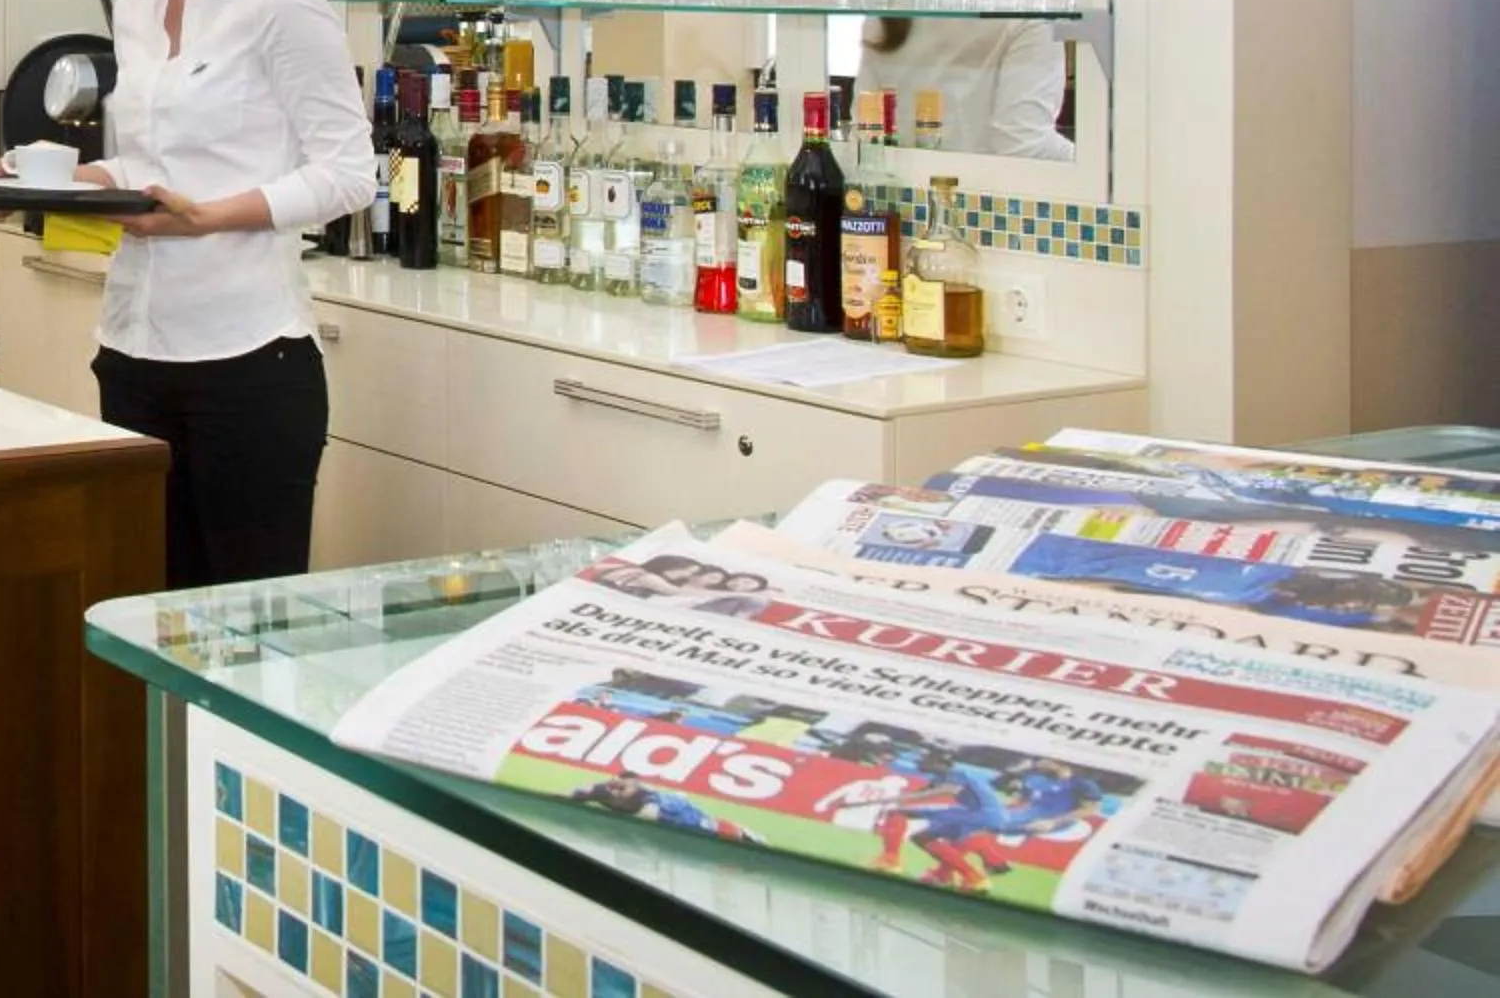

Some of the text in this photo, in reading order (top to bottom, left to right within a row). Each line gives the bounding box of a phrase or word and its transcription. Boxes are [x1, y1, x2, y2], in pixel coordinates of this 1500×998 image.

[542, 618, 593, 638] als
[602, 629, 673, 653] drei
[676, 645, 750, 670] Mal
[754, 663, 799, 680] so
[807, 672, 901, 702] viele
[908, 691, 1178, 757] Geschleppte
[570, 602, 715, 642] Doppelt
[716, 634, 760, 653] so
[769, 647, 859, 674] viele
[1088, 709, 1208, 740] mehr
[778, 608, 1180, 700] KURIER
[519, 713, 794, 799] ald's
